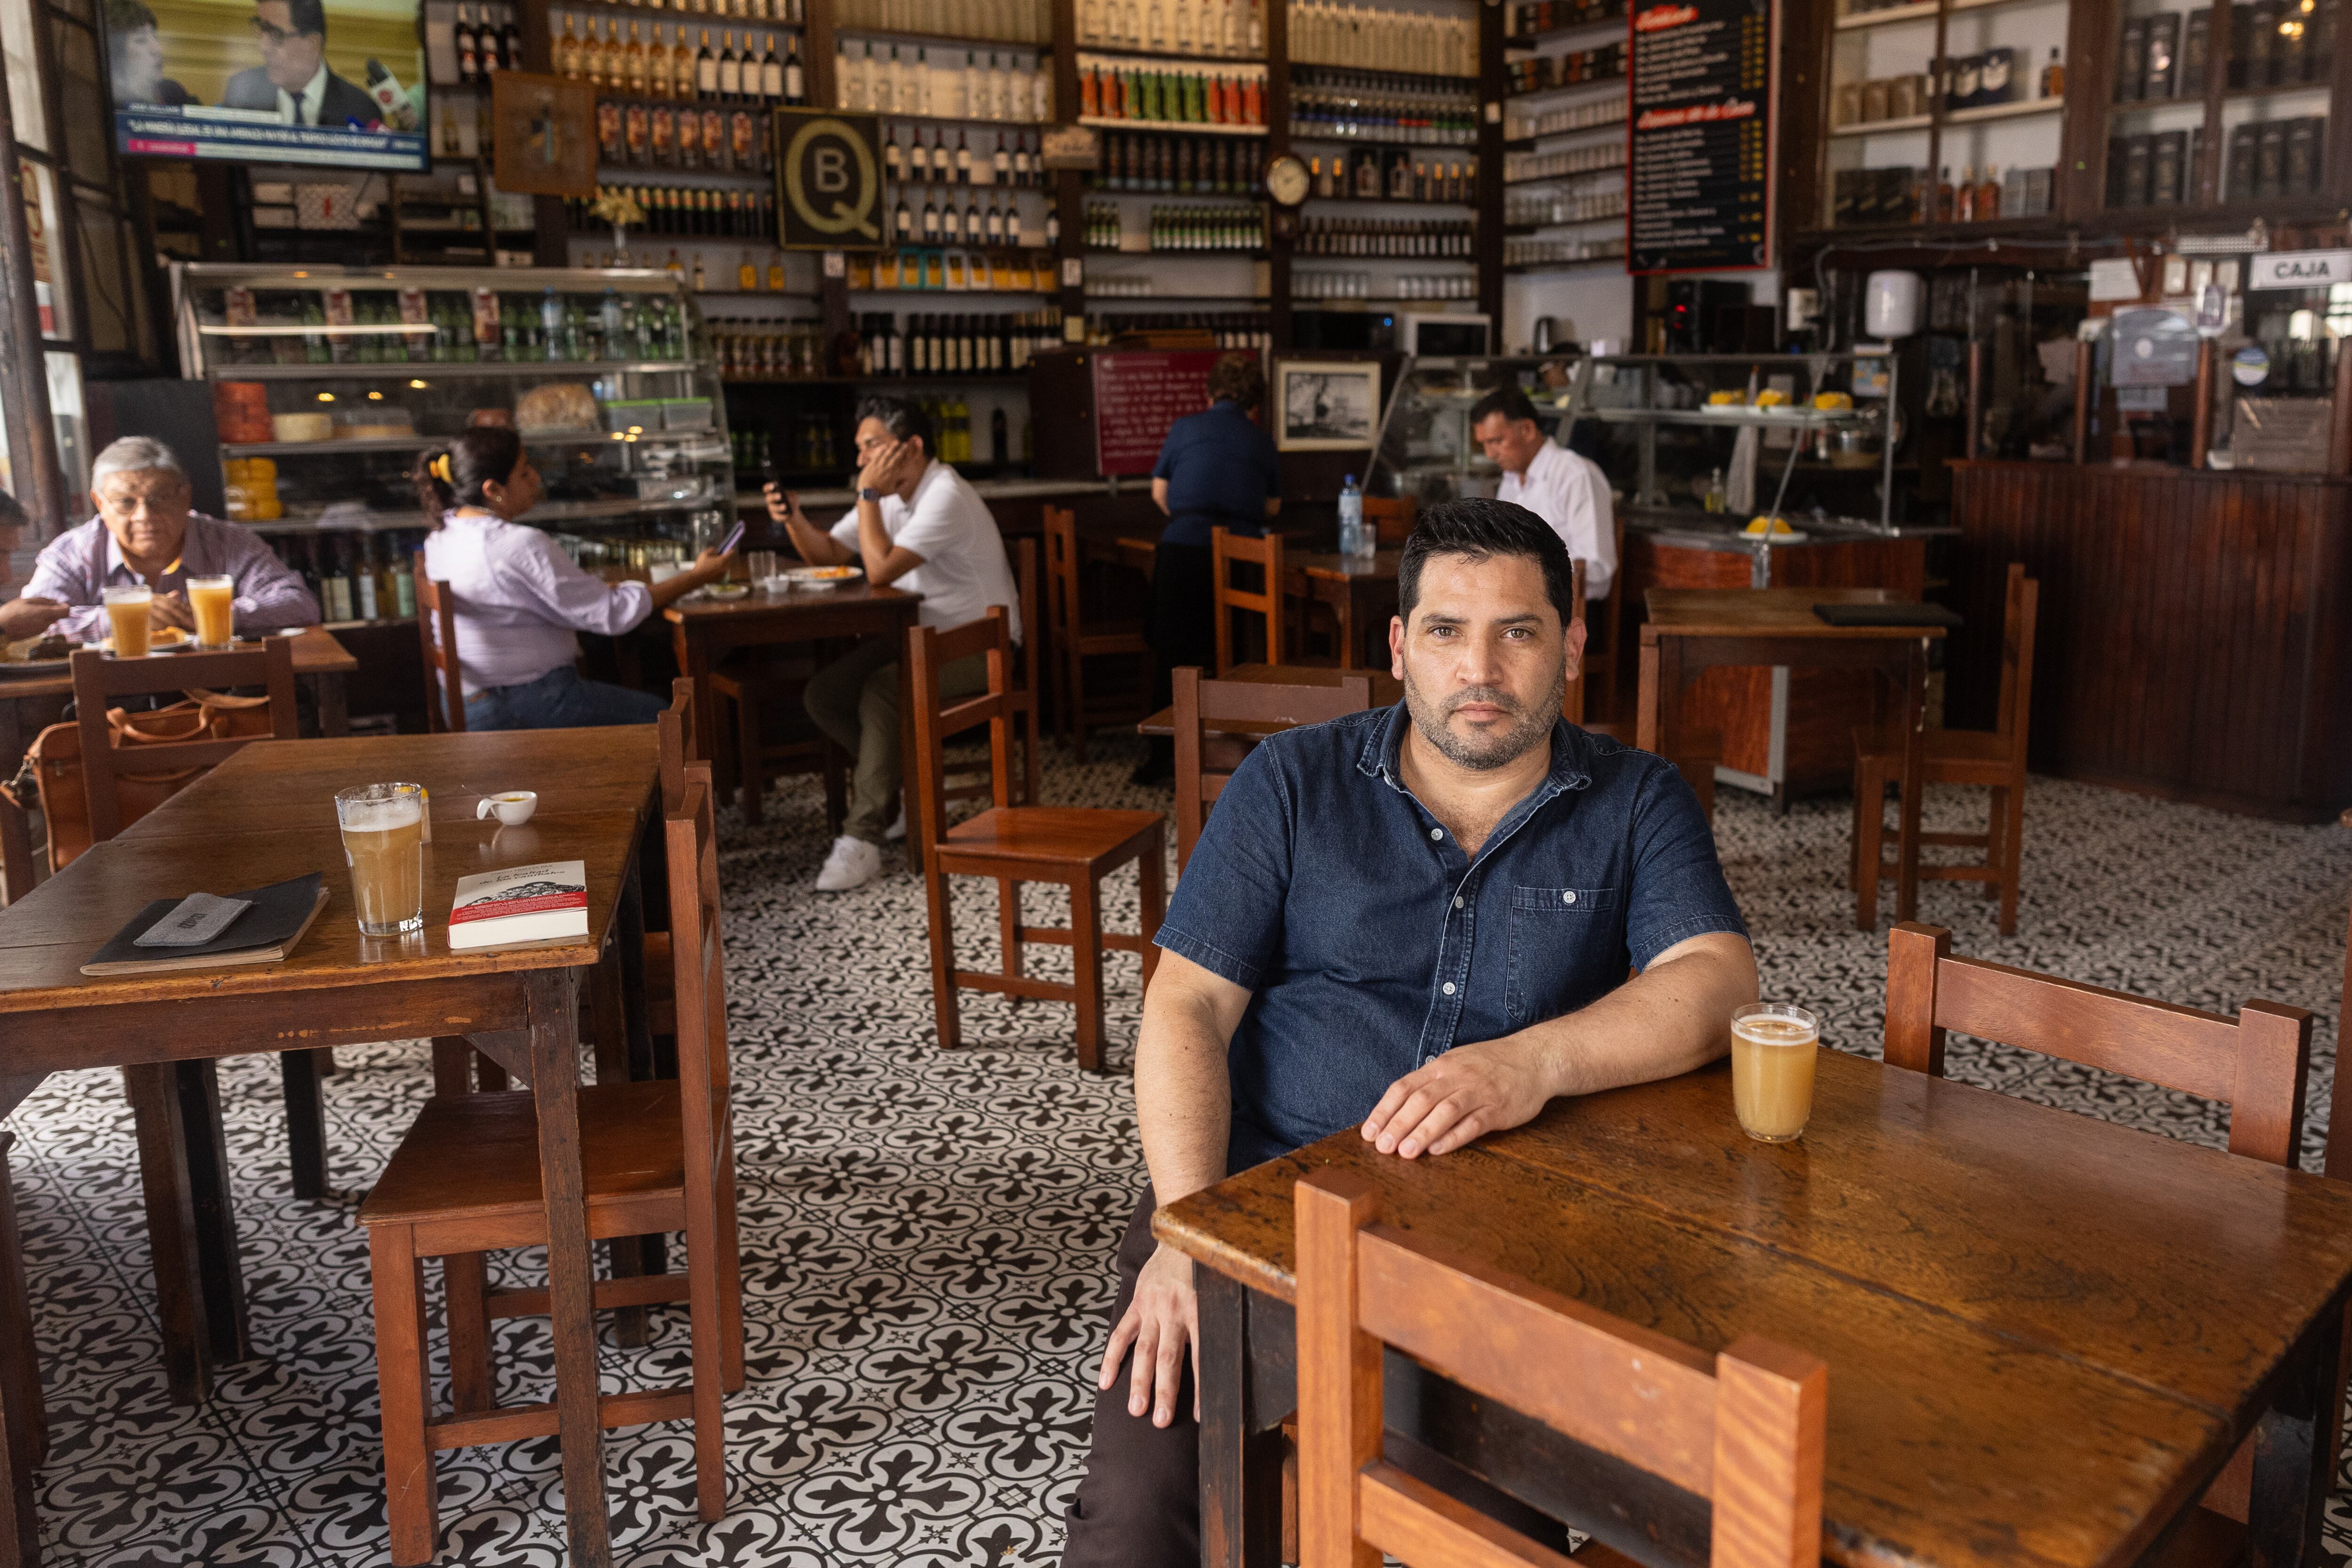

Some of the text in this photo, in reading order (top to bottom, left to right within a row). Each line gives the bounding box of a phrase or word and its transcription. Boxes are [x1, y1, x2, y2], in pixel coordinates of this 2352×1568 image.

[786, 119, 880, 239] Q
[815, 147, 847, 192] B
[2274, 260, 2330, 279] CAJA
